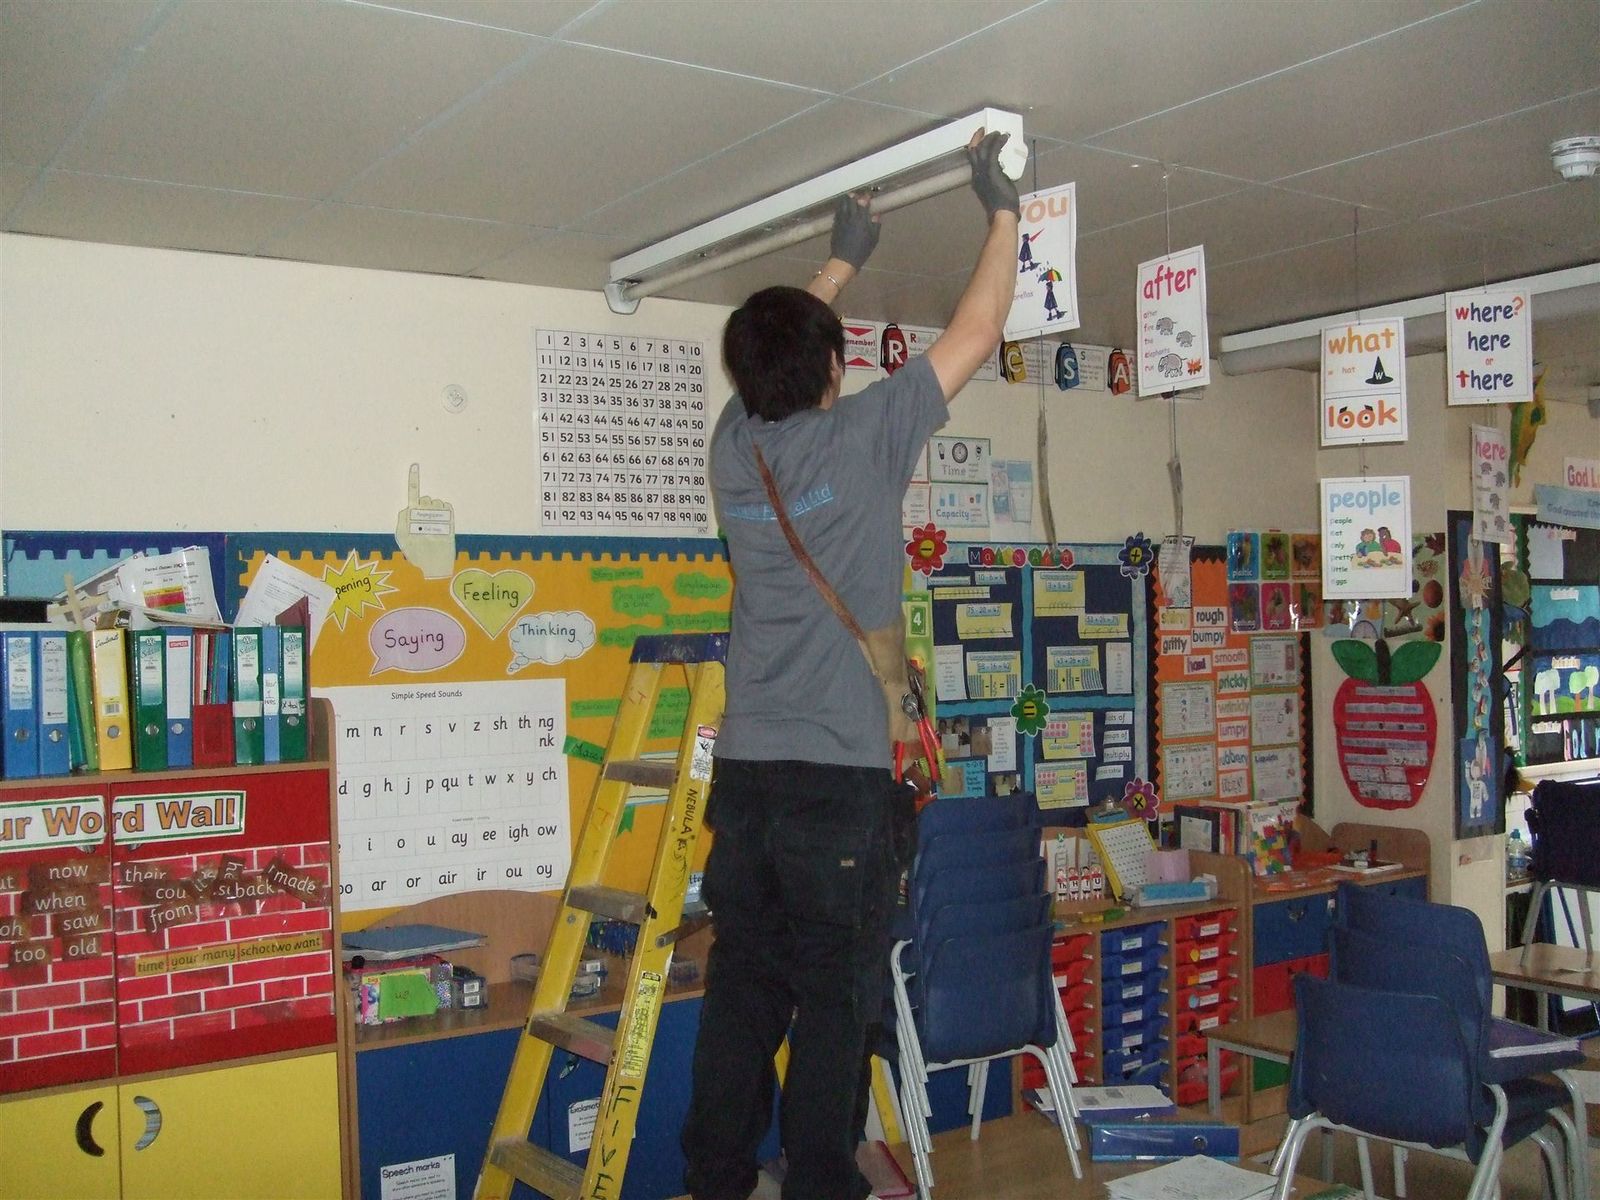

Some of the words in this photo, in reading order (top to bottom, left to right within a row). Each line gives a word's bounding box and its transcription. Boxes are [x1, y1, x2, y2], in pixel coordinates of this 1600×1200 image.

[1143, 264, 1197, 300] after
[1455, 296, 1523, 323] where?
[548, 336, 550, 344] 1
[564, 336, 570, 346] 2
[580, 338, 586, 347] 3
[597, 339, 603, 348] 4
[614, 340, 620, 350] 5
[630, 342, 636, 351] 6
[647, 343, 652, 352] 7
[663, 344, 669, 353] 8
[679, 345, 685, 354] 9
[691, 346, 700, 356] 10
[1328, 326, 1395, 354] what
[1468, 331, 1510, 351] here
[889, 339, 904, 364] R
[1484, 357, 1495, 366] or
[1064, 358, 1077, 380] S
[1114, 364, 1129, 385] A
[1456, 370, 1514, 390] there
[542, 413, 553, 422] 41
[560, 414, 572, 423] 42
[577, 414, 590, 424] 43
[594, 415, 607, 424] 44
[611, 416, 623, 425] 45
[627, 417, 640, 426] 46
[644, 418, 655, 427] 47
[660, 419, 672, 428] 48
[676, 419, 688, 428] 49
[692, 420, 703, 430] 50
[1328, 399, 1398, 429] look
[1475, 440, 1506, 461] here
[942, 464, 966, 476] Time
[1567, 464, 1588, 487] God
[1329, 484, 1400, 515] people
[546, 510, 556, 520] 91
[563, 511, 575, 520] 92
[580, 511, 593, 520] 93
[597, 511, 611, 520] 94
[615, 511, 627, 521] 95
[631, 512, 643, 521] 96
[647, 512, 659, 521] 97
[664, 512, 676, 521] 98
[680, 512, 691, 521] 99
[694, 513, 707, 522] 100
[936, 508, 970, 520] Capacity
[335, 576, 371, 597] pening
[463, 583, 519, 608] Feeling
[912, 612, 922, 626] 4
[1196, 609, 1225, 624] rough
[384, 629, 444, 654] Saying
[519, 622, 576, 643] Thinking
[1192, 630, 1225, 643] bumpy
[1162, 637, 1188, 651] gritty
[1214, 650, 1247, 663] smooth
[391, 691, 414, 700] Simple
[416, 690, 436, 699] Speed
[438, 690, 463, 698] Sounds
[346, 726, 360, 738] m
[373, 725, 382, 737] n
[399, 724, 406, 735] r
[425, 723, 432, 734] s
[448, 722, 456, 733] v
[473, 720, 480, 731] z
[493, 716, 507, 730] sh
[518, 715, 531, 729] th
[538, 716, 554, 731] ng
[539, 733, 554, 747] nk
[339, 781, 347, 795] d
[363, 782, 371, 797] g
[384, 778, 392, 792] h
[405, 778, 410, 794] j
[426, 777, 434, 793] p
[441, 776, 459, 791] qu
[468, 774, 473, 786] t
[485, 774, 496, 784] w
[507, 772, 514, 784] x
[526, 771, 534, 785] y
[542, 767, 557, 781] ch
[42, 803, 145, 838] Word
[156, 798, 236, 830] Wall
[681, 788, 698, 834] NEBULA
[368, 838, 372, 851] i
[397, 838, 405, 849] o
[427, 835, 436, 846] u
[451, 833, 468, 847] ay
[482, 829, 496, 840] ee
[509, 824, 529, 841] igh
[537, 824, 557, 836] ow
[50, 864, 89, 881] now
[125, 866, 167, 884] their
[274, 870, 315, 895] made
[371, 879, 386, 892] ar
[406, 875, 421, 888] or
[438, 871, 458, 885] air
[477, 868, 486, 881] ir
[505, 866, 522, 878] ou
[536, 863, 553, 878] oy
[235, 882, 274, 898] back
[35, 893, 87, 912] when
[63, 912, 99, 931] saw
[150, 903, 194, 932] from
[14, 945, 46, 963] too
[68, 937, 98, 957] old
[138, 959, 165, 972] time
[172, 955, 198, 970] your
[202, 947, 236, 961] many
[293, 937, 321, 950] want
[382, 1166, 414, 1179] Speech
[415, 1161, 441, 1173] marks
